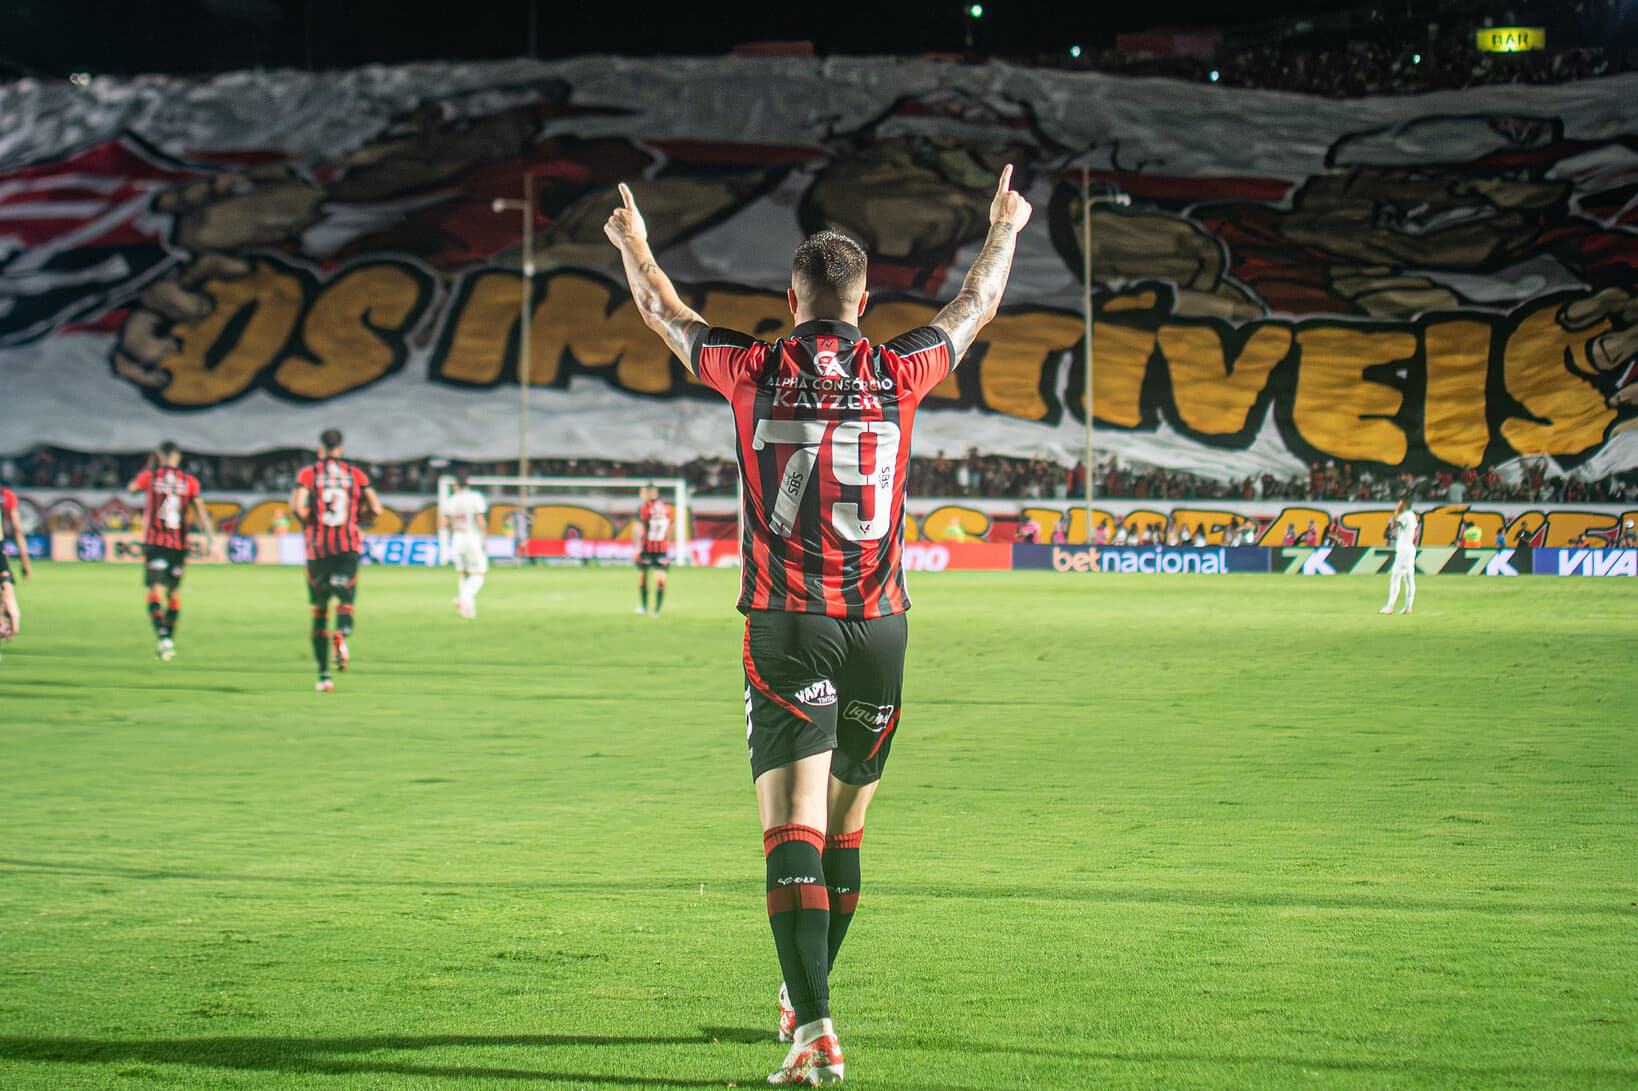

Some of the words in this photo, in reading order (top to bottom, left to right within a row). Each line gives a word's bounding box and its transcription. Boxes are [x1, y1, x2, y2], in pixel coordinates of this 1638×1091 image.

[766, 376, 808, 389] ALPHA
[772, 387, 883, 411] KAYZER
[752, 419, 900, 541] 79
[787, 471, 804, 497] SBS
[1282, 549, 1336, 576] 7K
[1464, 549, 1518, 576] 7K
[1558, 549, 1637, 577] VIVA
